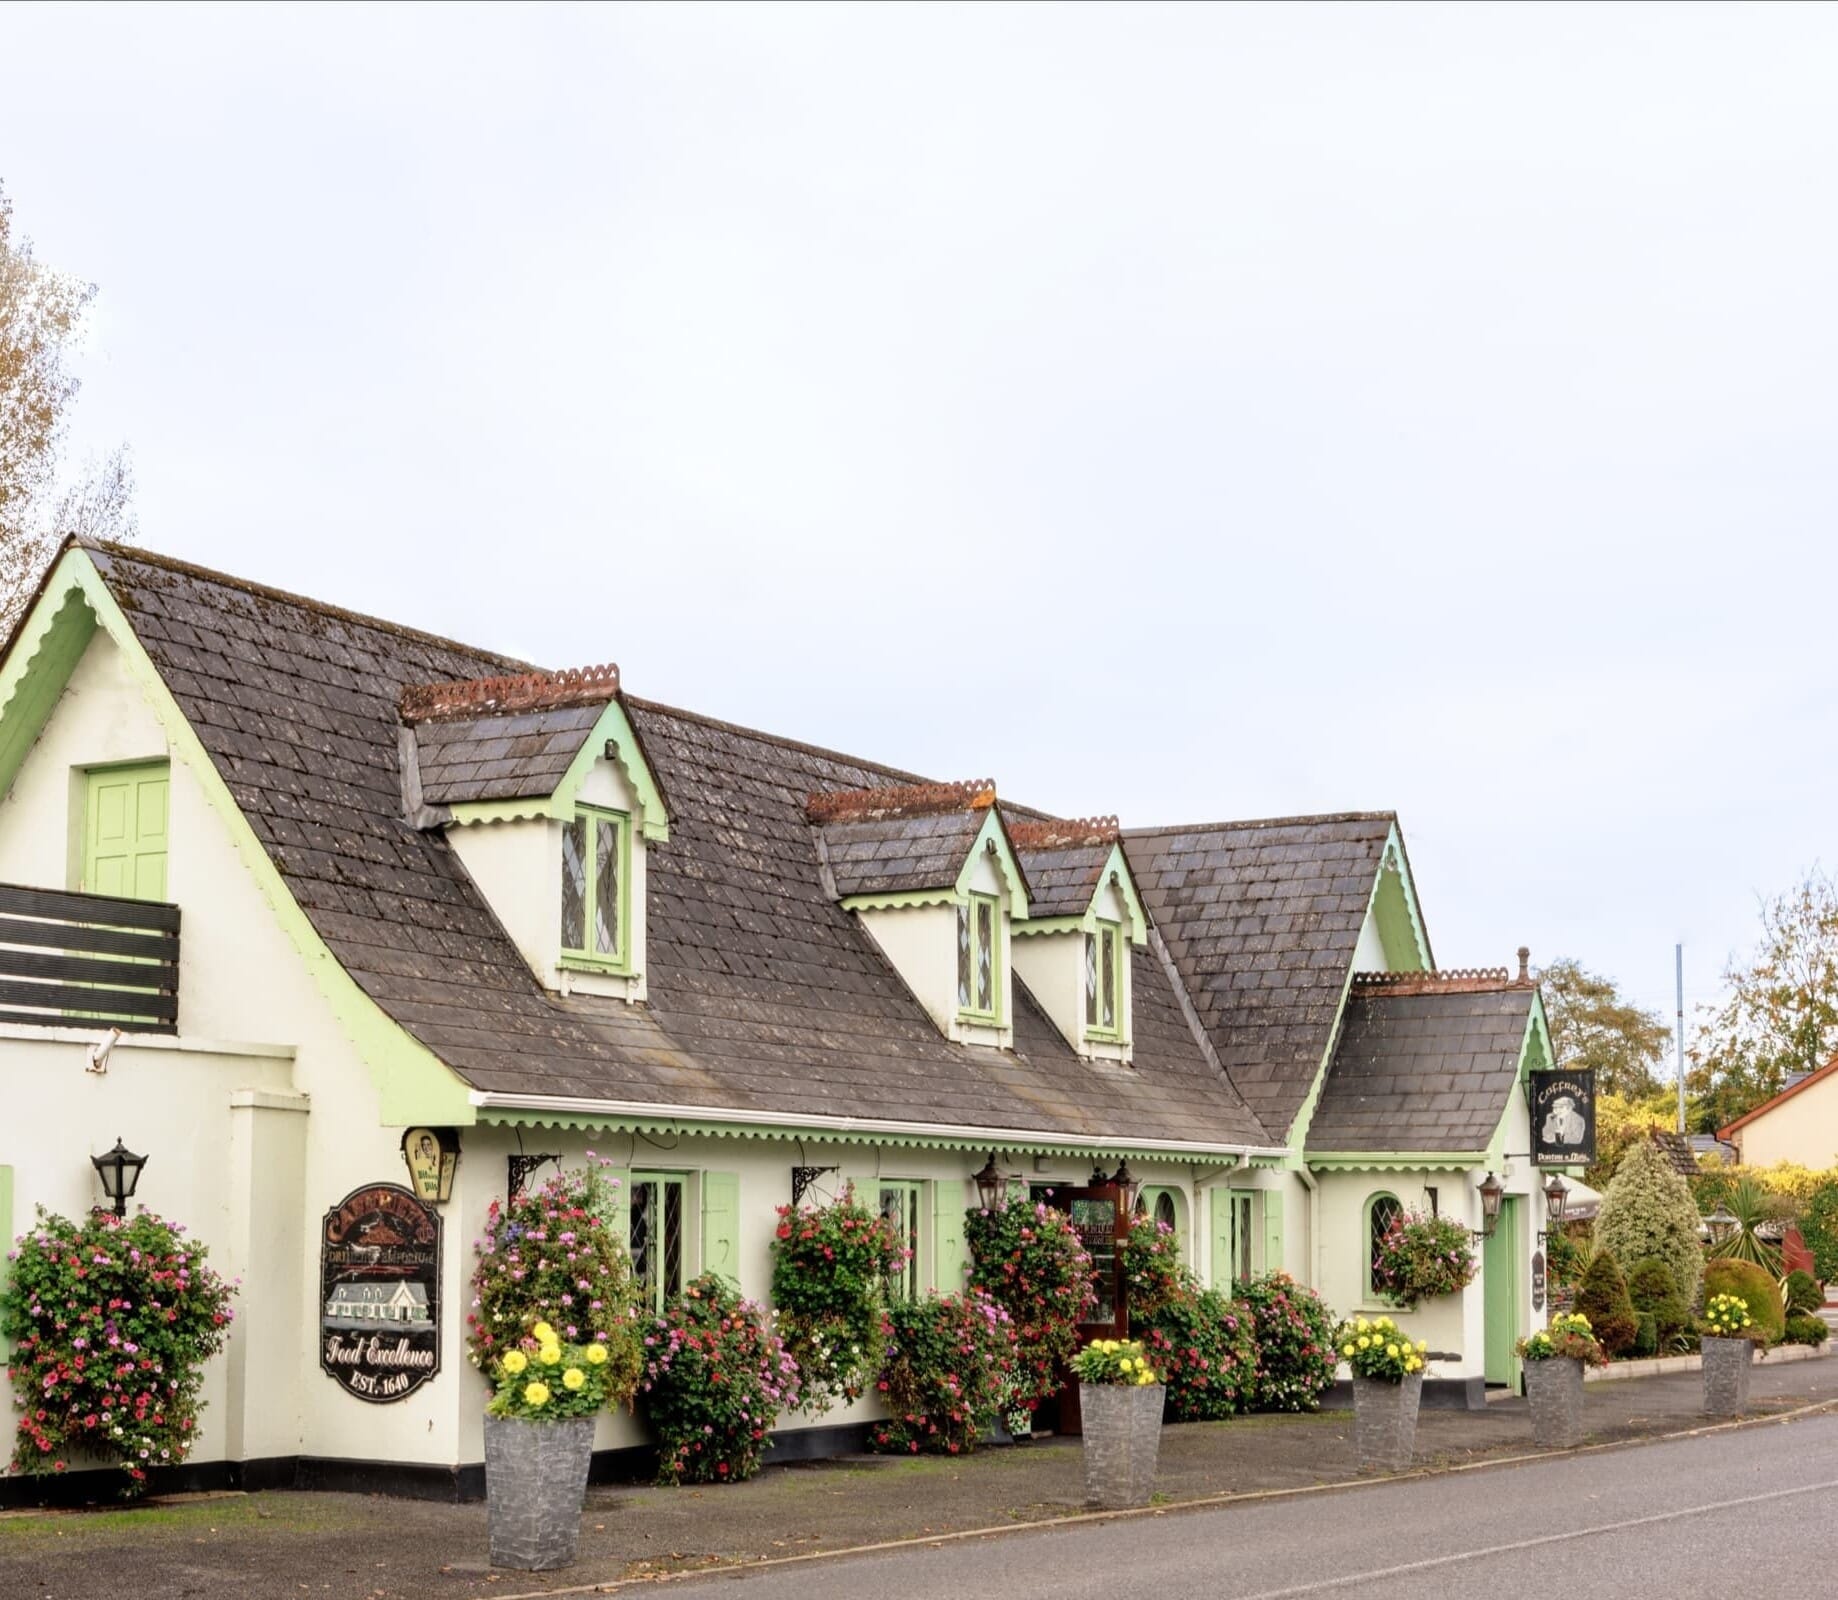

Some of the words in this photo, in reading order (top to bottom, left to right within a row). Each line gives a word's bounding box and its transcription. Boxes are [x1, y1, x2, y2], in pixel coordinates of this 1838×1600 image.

[326, 1336, 364, 1364] Food
[366, 1336, 434, 1367] Excellence
[350, 1371, 378, 1394] EST.
[382, 1373, 409, 1394] 1640
